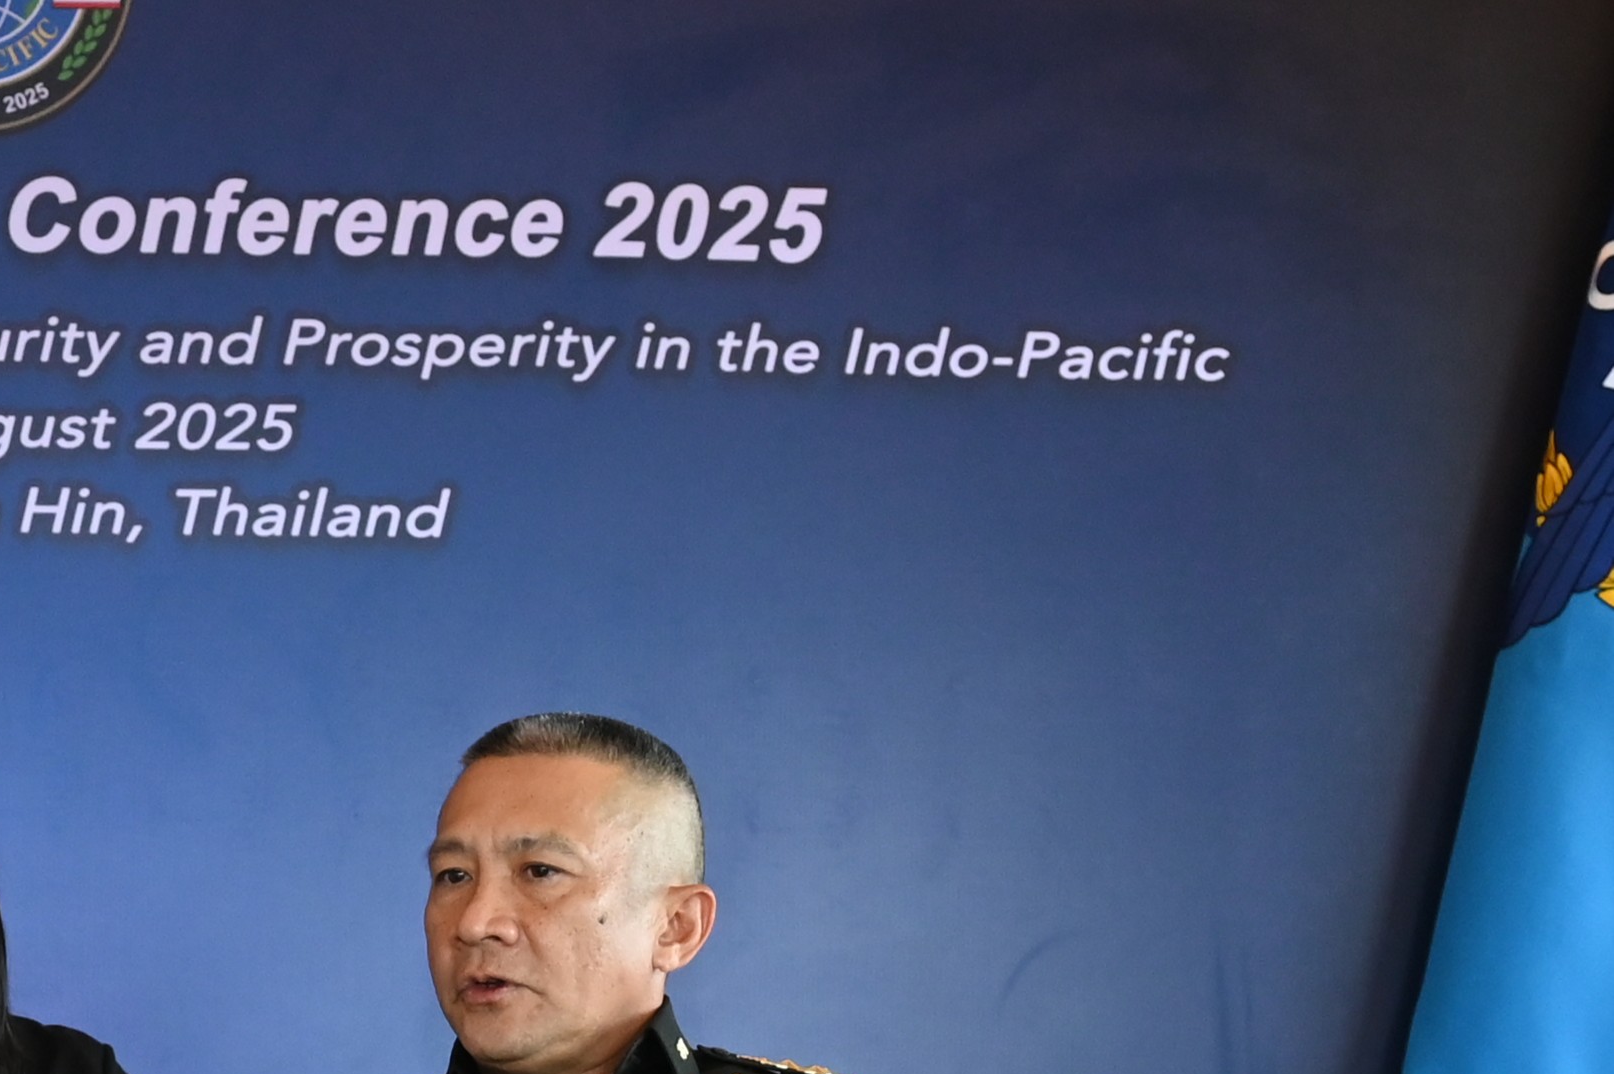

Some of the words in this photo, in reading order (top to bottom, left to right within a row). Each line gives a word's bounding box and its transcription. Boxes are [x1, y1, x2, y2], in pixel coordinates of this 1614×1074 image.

[3, 82, 50, 113] 2025
[8, 176, 564, 258] Conference
[593, 182, 828, 264] 2025
[139, 315, 264, 366] and
[283, 318, 616, 382] Prosperity
[636, 322, 691, 370] in
[717, 322, 820, 374] the
[844, 326, 1230, 382] Indo-Pacific
[134, 401, 297, 452] 2025
[20, 486, 143, 544] Hin,
[175, 485, 452, 539] Thailand
